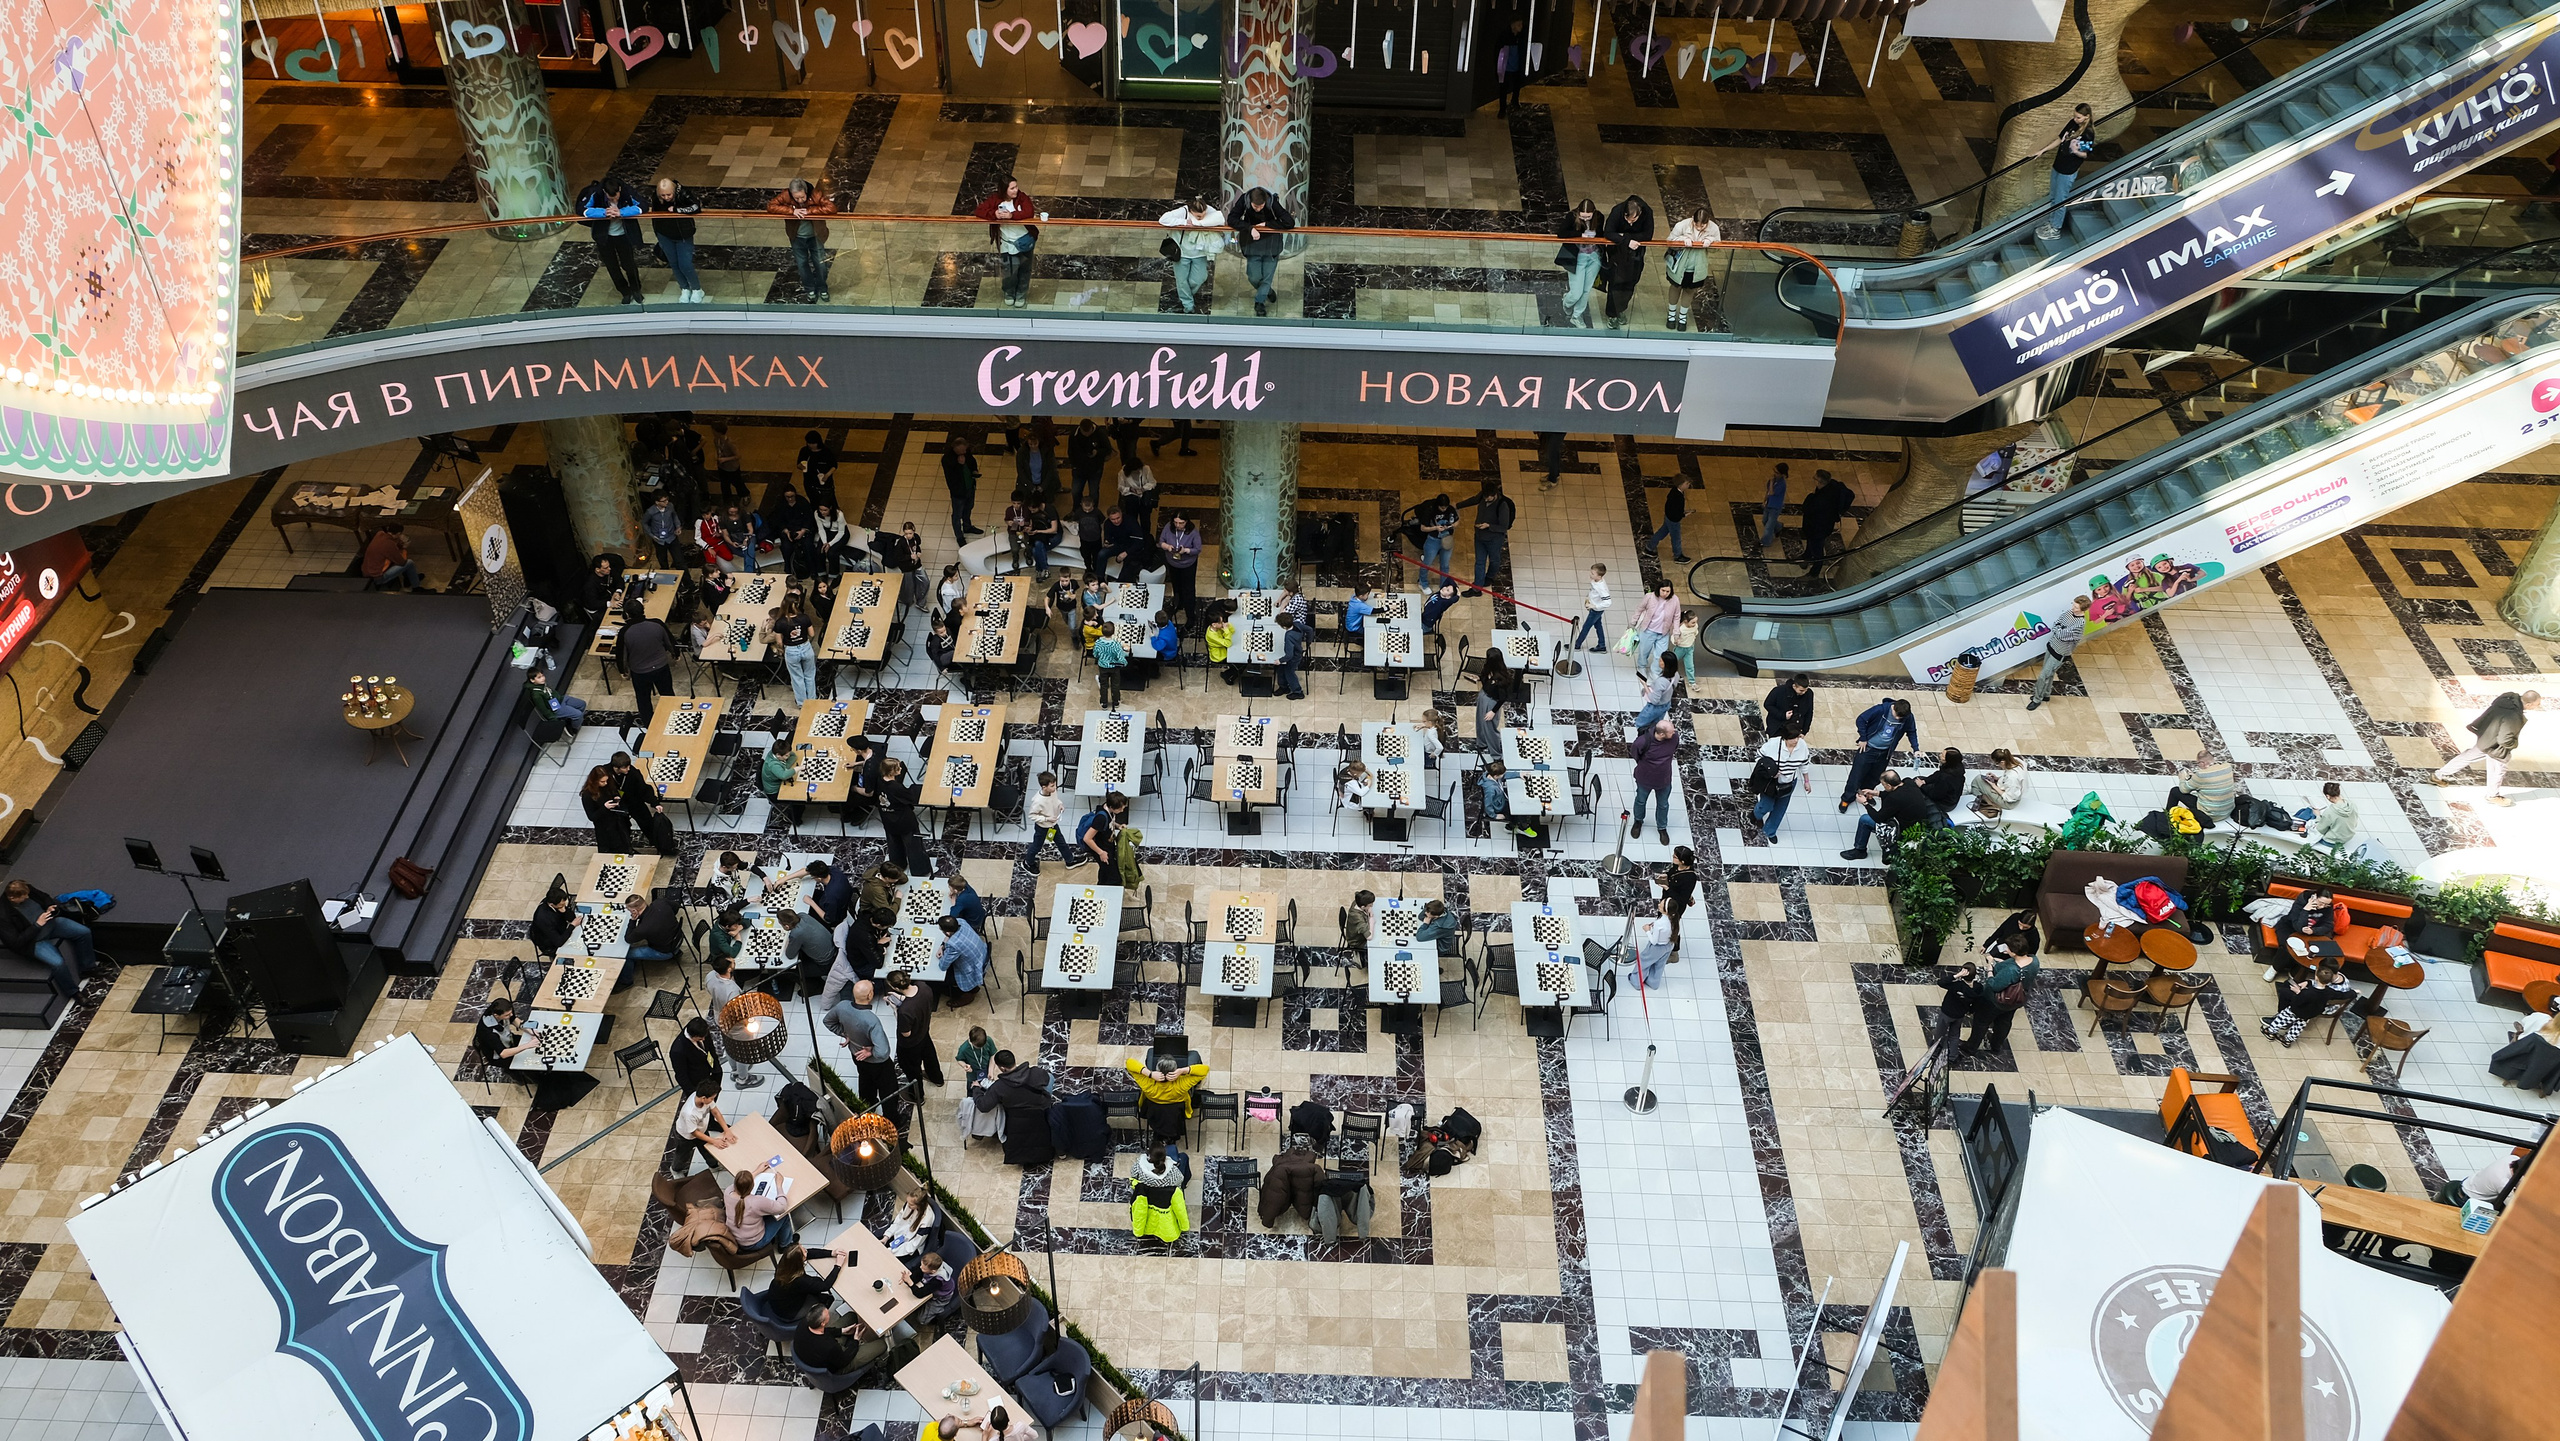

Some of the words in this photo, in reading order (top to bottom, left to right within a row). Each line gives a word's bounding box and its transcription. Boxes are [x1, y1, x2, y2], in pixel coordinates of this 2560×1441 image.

[2147, 204, 2272, 280] IMAX
[2203, 225, 2278, 268] SAPPHIRE
[2016, 324, 2085, 365] формула
[2086, 305, 2125, 331] кино
[242, 391, 361, 441] ЧАЯ
[380, 382, 413, 417] В
[434, 355, 829, 409] ПИРАМИДКАХ
[1359, 370, 1543, 409] НОВАЯ
[1564, 378, 1683, 414] КОЛ
[2520, 423, 2534, 435] 2
[2224, 476, 2348, 537] ВЕРЕВОЧНЫЙ
[2239, 519, 2300, 551] АКТИВНОГО
[2300, 499, 2346, 523] ОТДЫХА
[2229, 519, 2277, 545] ПАРК
[0, 573, 21, 601] марта
[0, 605, 31, 648] ТУРНИР
